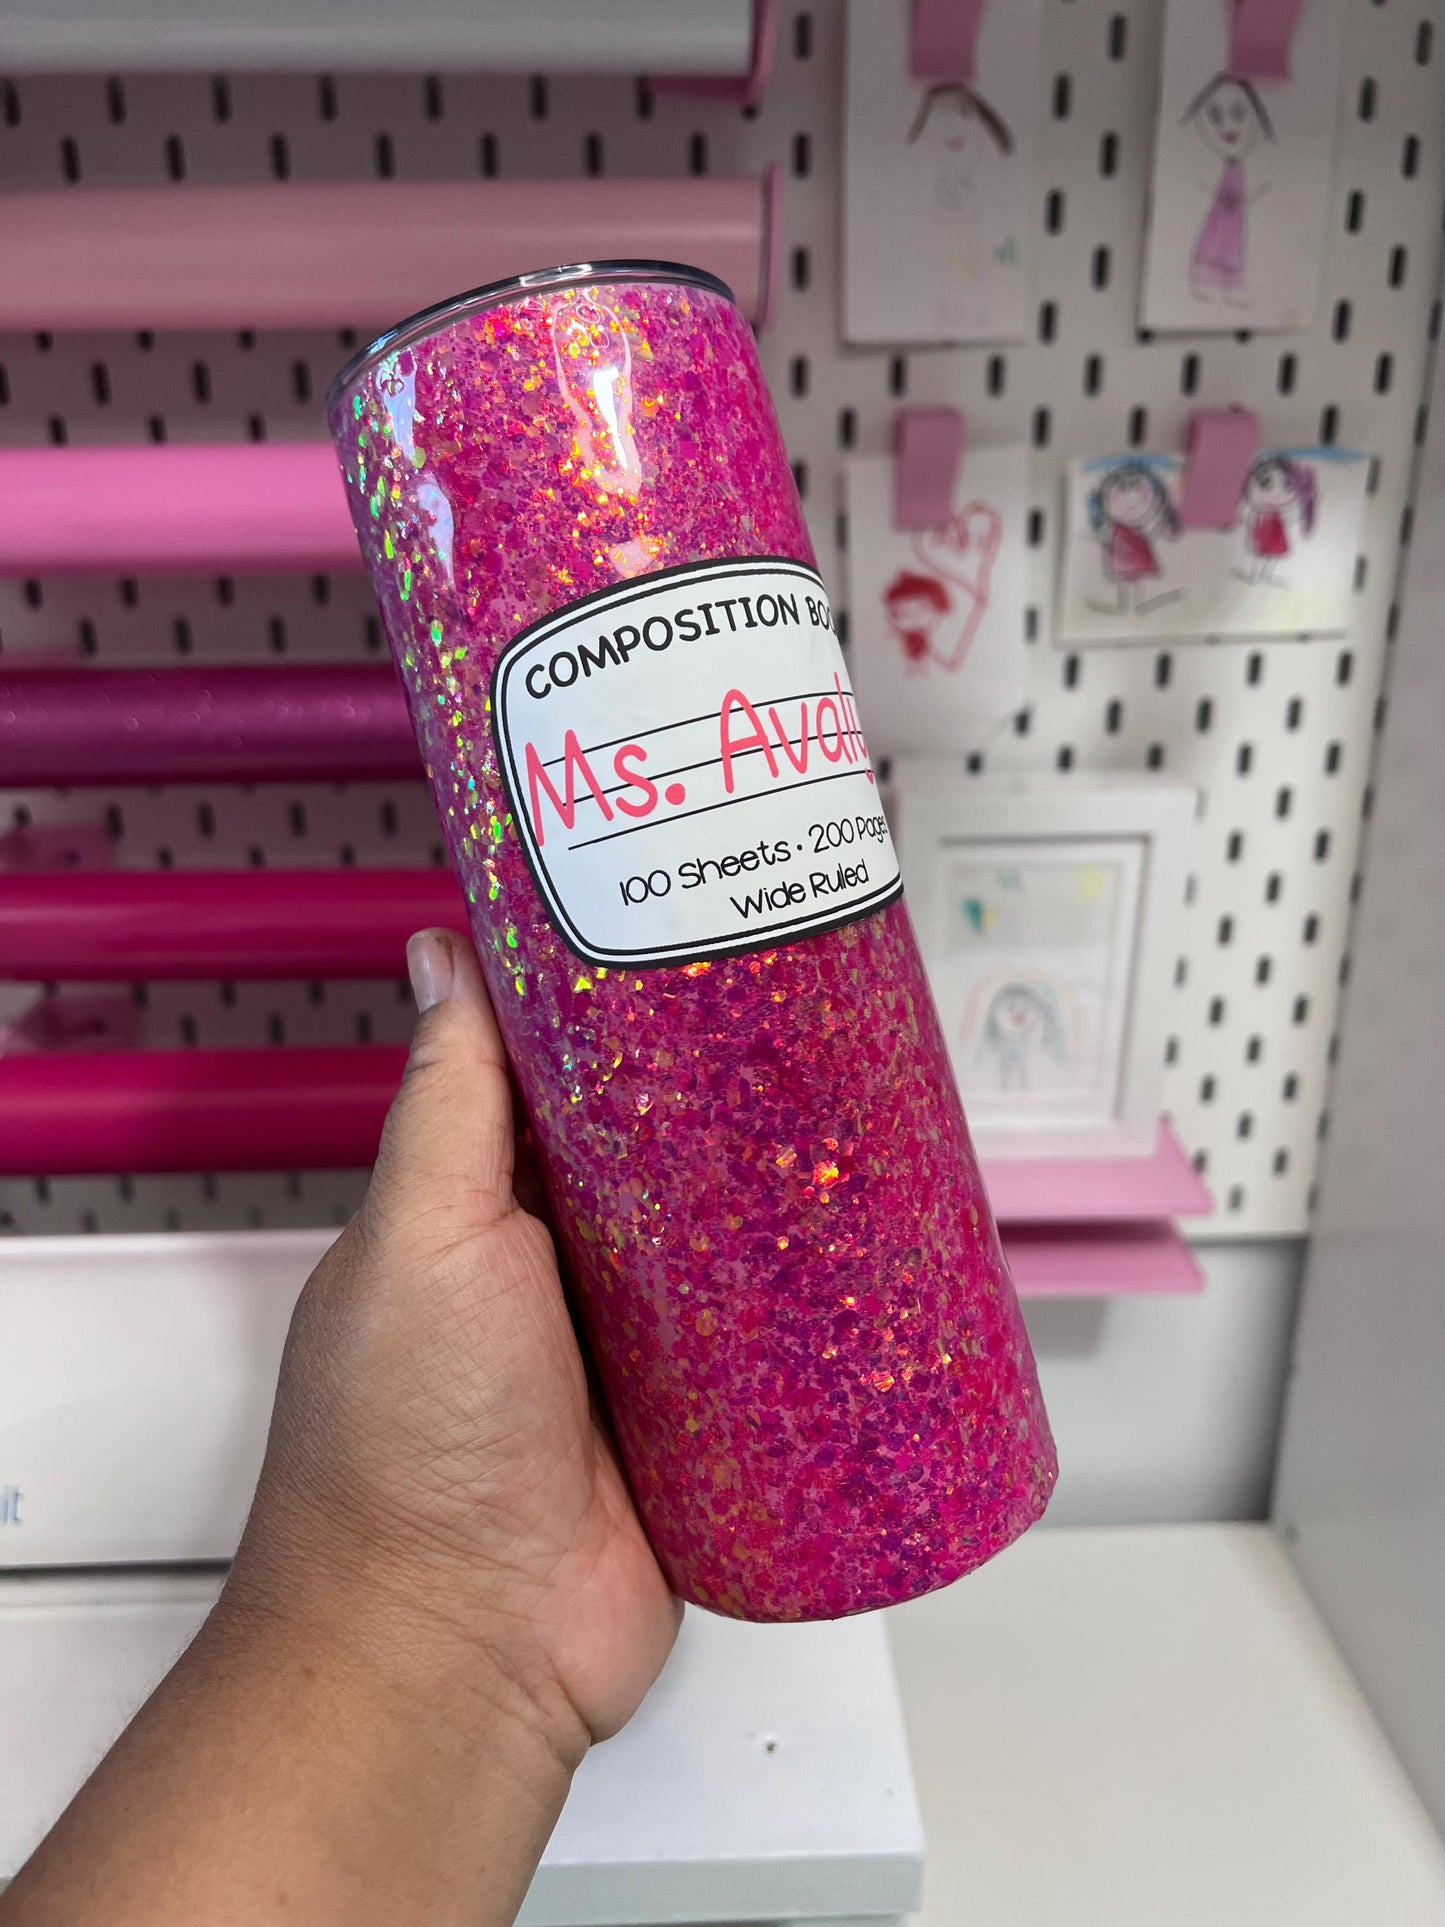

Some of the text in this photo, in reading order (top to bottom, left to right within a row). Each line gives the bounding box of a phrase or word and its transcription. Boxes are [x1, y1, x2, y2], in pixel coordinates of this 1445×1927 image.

[526, 593, 800, 699] COMPOSITION
[525, 729, 686, 847] Ms.
[619, 869, 672, 906] 100
[678, 840, 792, 889] Sheets
[808, 818, 855, 853] 200
[729, 858, 870, 919] Wide Ruled
